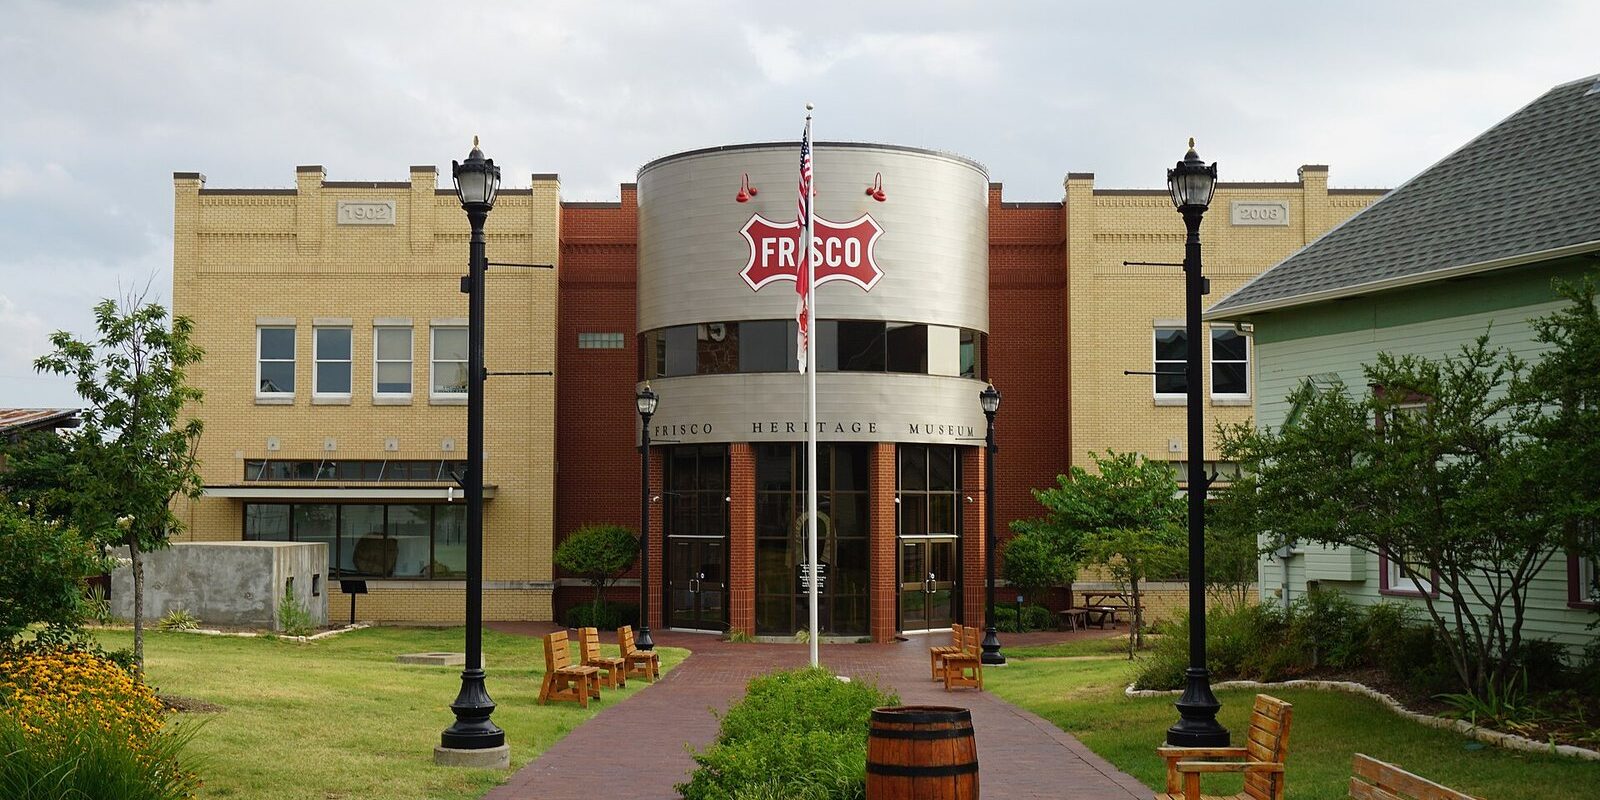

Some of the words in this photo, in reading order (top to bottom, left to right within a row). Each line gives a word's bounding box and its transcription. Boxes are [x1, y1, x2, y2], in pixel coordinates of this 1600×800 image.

[344, 207, 387, 220] 1902
[1240, 208, 1280, 220] 2008
[655, 423, 713, 436] FRISCO
[752, 422, 877, 433] HERITAGE
[909, 423, 974, 437] MUSEUM
